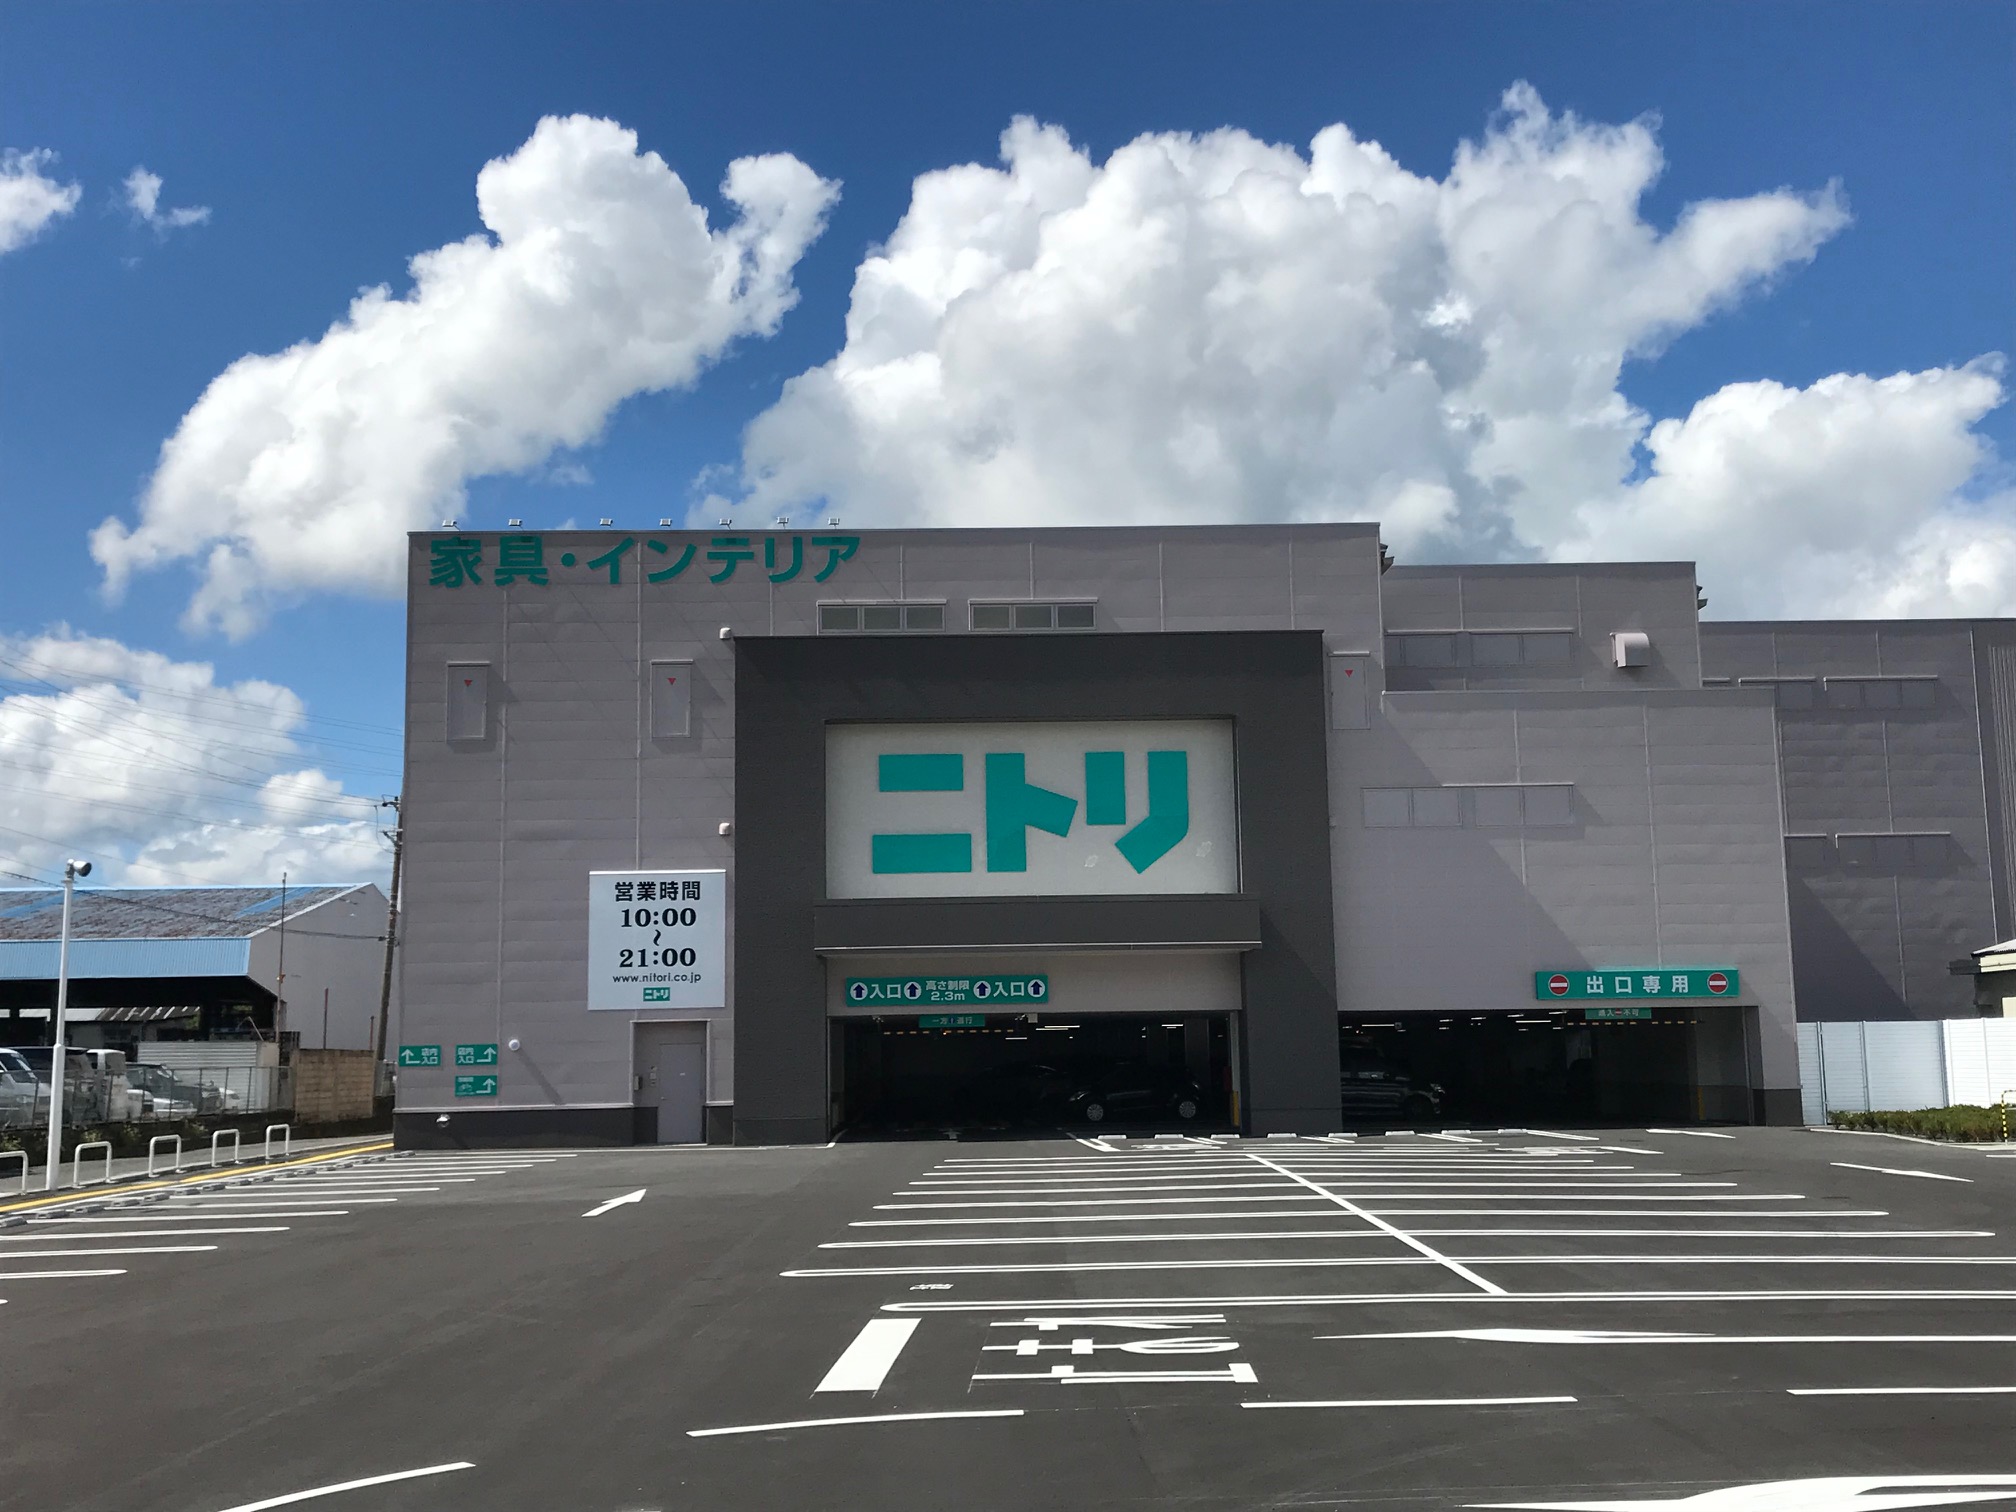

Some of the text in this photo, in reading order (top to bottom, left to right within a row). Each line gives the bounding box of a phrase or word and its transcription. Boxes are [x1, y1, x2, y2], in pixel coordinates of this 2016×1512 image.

[429, 536, 860, 588] 家具・インテリア
[872, 751, 1189, 874] ニトリ
[615, 881, 701, 902] 営業時間
[621, 908, 697, 927] 10:00
[619, 948, 696, 968] 21:00
[612, 972, 702, 984] www.nitori.co.jp
[925, 980, 970, 991] 高さ制限
[1586, 975, 1689, 994] 出口専用
[644, 989, 669, 1000] ニトリ
[869, 983, 901, 999] 入口
[930, 991, 966, 1001] 2.3m
[993, 981, 1025, 998] 入口
